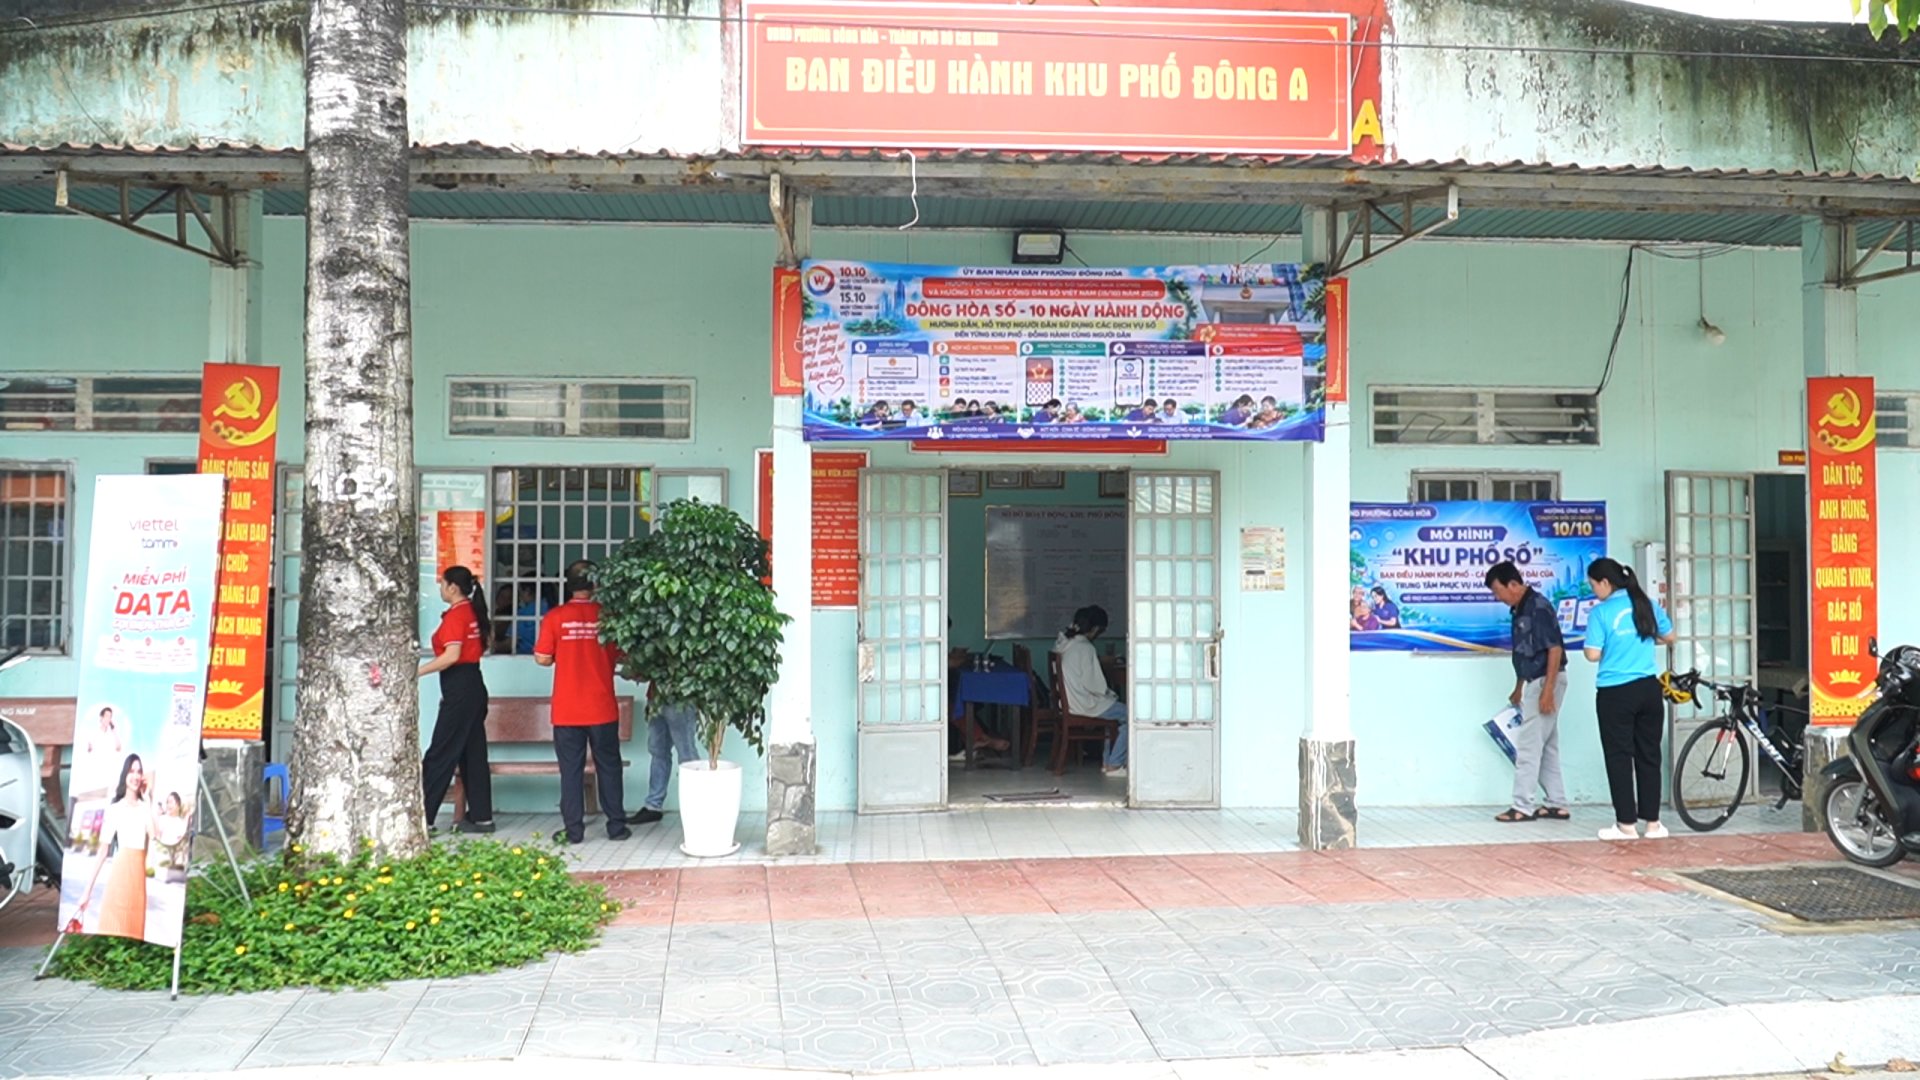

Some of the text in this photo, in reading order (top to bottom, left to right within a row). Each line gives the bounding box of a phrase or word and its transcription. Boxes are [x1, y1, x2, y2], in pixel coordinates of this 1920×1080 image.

[786, 46, 1308, 101] BAN ĐIỀU HÀNH KHU PHỐ ĐÔNG A
[1352, 99, 1382, 144] A
[840, 268, 866, 277] 10.10
[840, 292, 866, 302] 15.10
[906, 300, 952, 317] ĐÔNG
[956, 301, 991, 317] HÒA
[995, 300, 1016, 317] SỐ
[1029, 304, 1046, 317] 10
[1050, 302, 1090, 318] NGÀY
[1094, 302, 1137, 318] HÀNH
[1141, 303, 1184, 320] ĐỘNG
[227, 456, 250, 483] CỘNG
[252, 455, 269, 480] SẢN
[1823, 461, 1863, 489] DÂN TỘC
[231, 491, 251, 510] NAM
[1361, 508, 1391, 517] PHƯỜNG
[1393, 508, 1414, 517] ĐÔNG
[1416, 508, 1431, 517] HÒA
[1819, 495, 1869, 521] ANH HÙNG,
[129, 519, 179, 531] viettel
[226, 519, 267, 547] LÃNH ĐẠO
[1430, 526, 1493, 540] MÔ HÌNH
[1552, 521, 1592, 536] 10/10
[1831, 527, 1857, 553] ĐẢNG
[226, 550, 249, 572] CHỨC
[1455, 541, 1500, 566] PHỐ
[162, 565, 187, 584] PHÍ
[1396, 569, 1413, 578] ĐIỀU
[1415, 570, 1435, 578] HÀNH
[1454, 569, 1469, 578] PHỐ
[1526, 568, 1538, 578] DÀI
[1539, 567, 1554, 578] CỦA
[1816, 567, 1874, 590] QUANG VINH,
[246, 584, 260, 608] LỢI
[1422, 581, 1438, 589] TÂM
[1440, 581, 1459, 590] PHỤC
[1461, 582, 1472, 590] VỤ
[115, 589, 191, 616] DATA
[1827, 597, 1847, 622] BÁC
[236, 616, 262, 640] MẠNG
[211, 643, 225, 669] ỆT
[226, 647, 246, 666] NAM
[1831, 632, 1859, 660] VĨ ĐẠI
